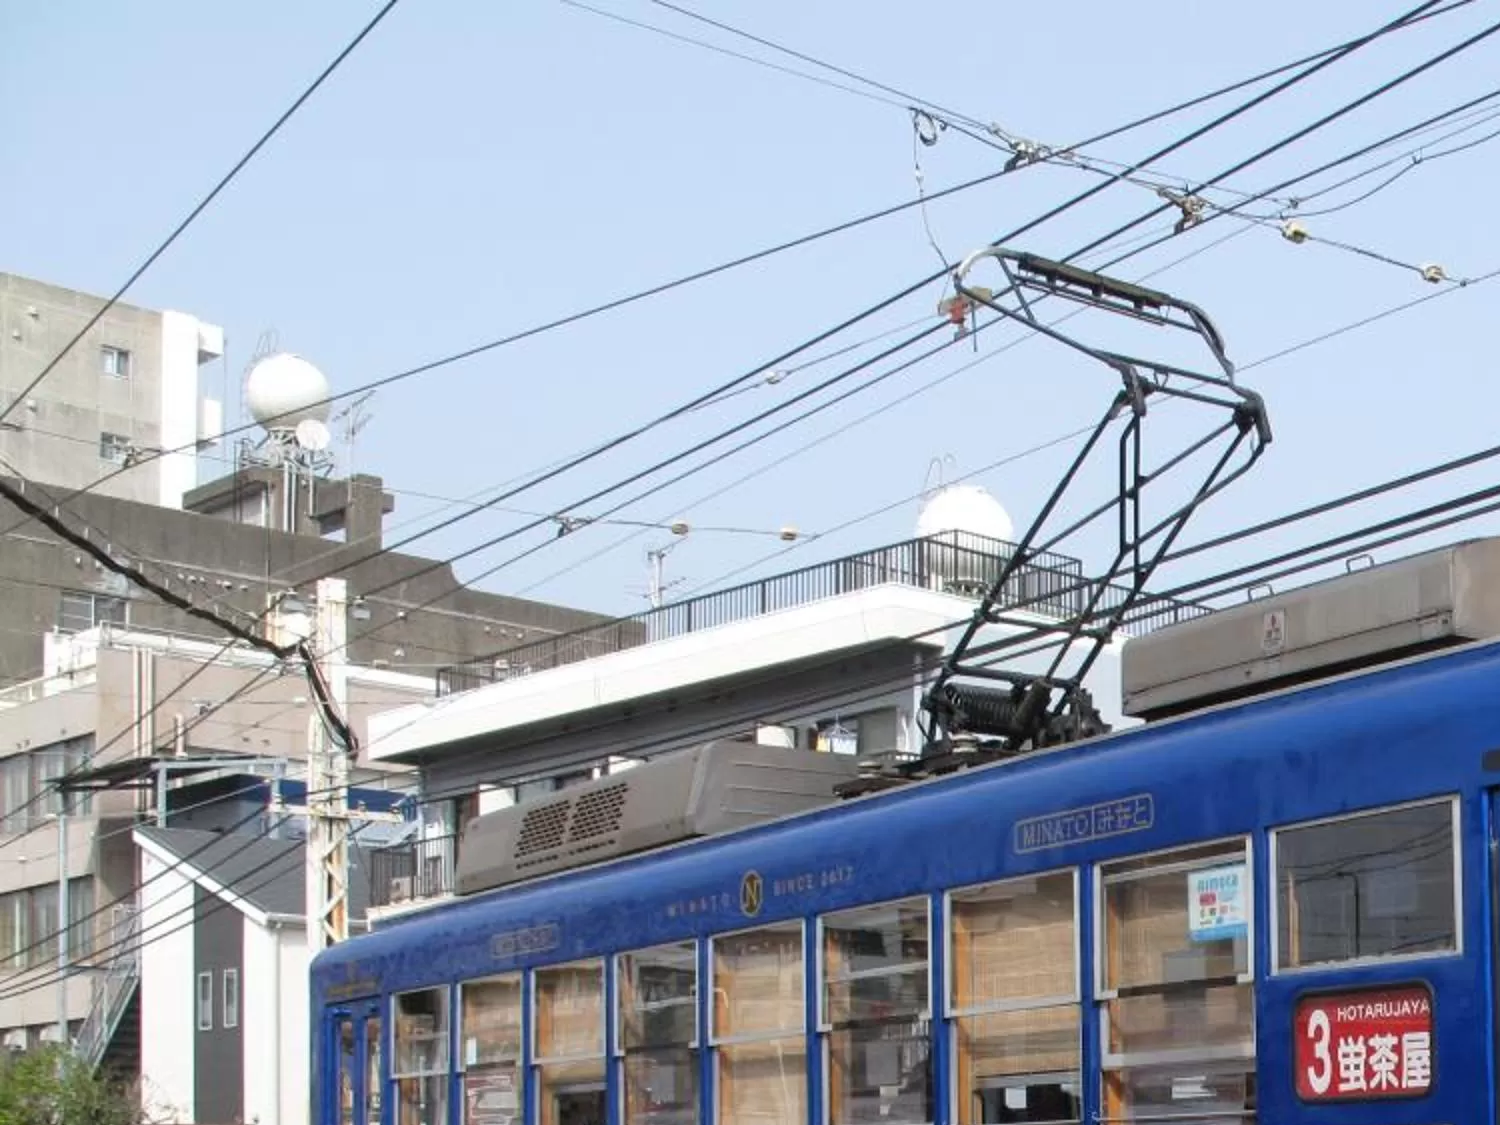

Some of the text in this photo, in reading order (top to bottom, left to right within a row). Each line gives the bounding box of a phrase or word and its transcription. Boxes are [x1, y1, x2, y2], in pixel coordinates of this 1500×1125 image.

[1023, 799, 1148, 847] MINATO みなと
[1337, 1000, 1430, 1022] HOTARUJAYA
[1308, 1009, 1332, 1095] 3
[1338, 1031, 1431, 1092] 蛍茶屋
